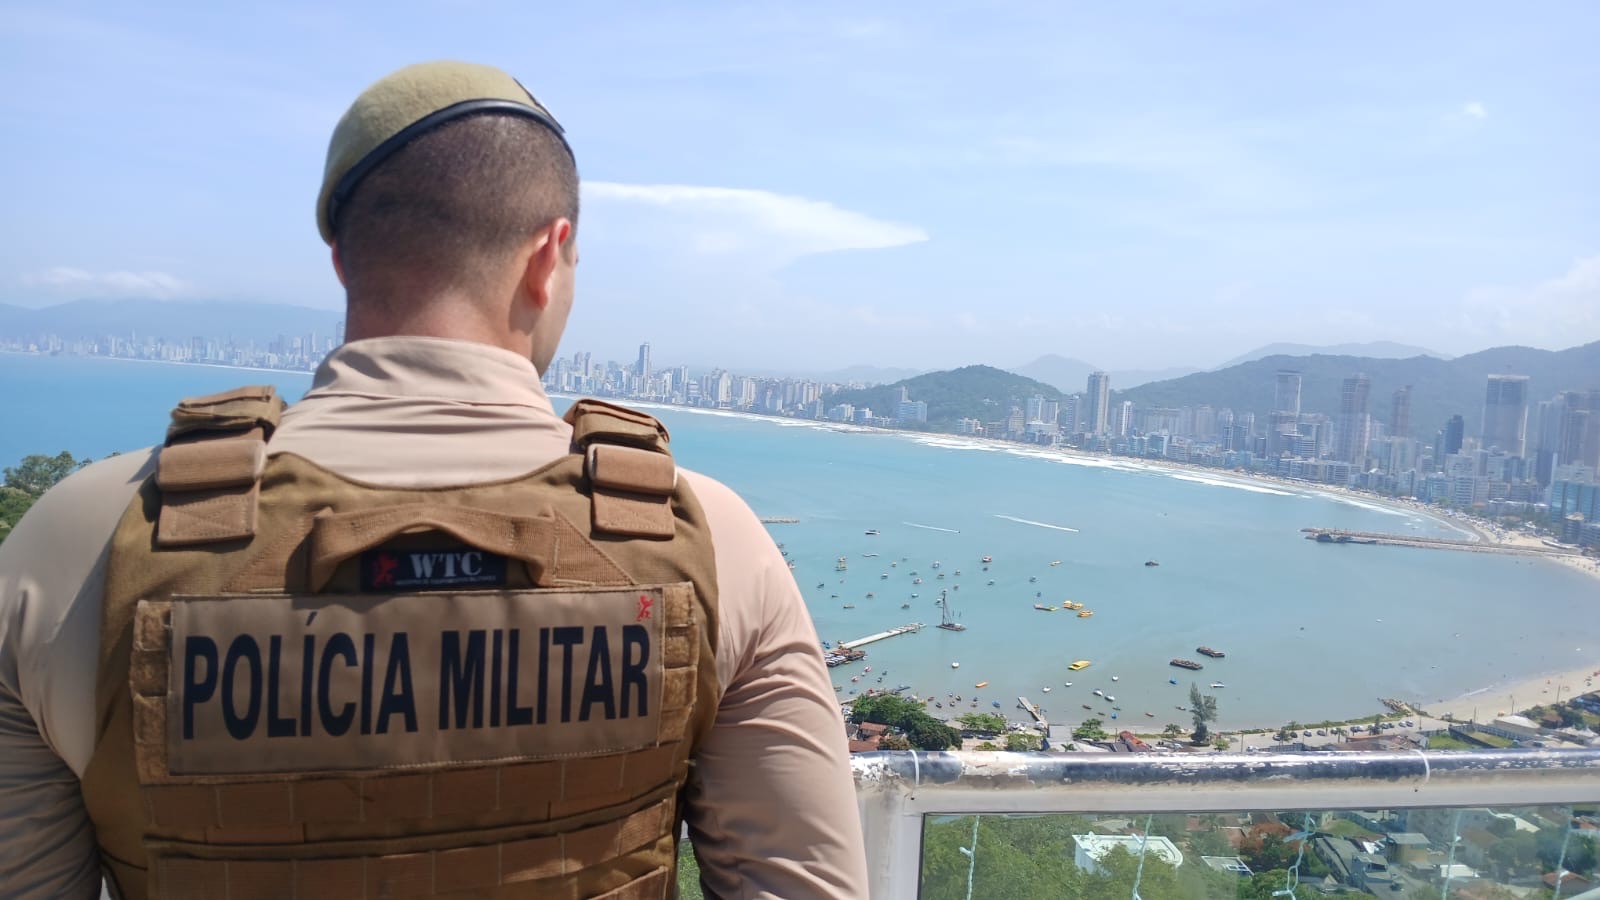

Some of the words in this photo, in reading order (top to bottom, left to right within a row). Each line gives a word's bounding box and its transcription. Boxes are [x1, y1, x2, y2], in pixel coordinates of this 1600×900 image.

[410, 552, 482, 578] WTC
[183, 612, 418, 740] POLÍCIA
[438, 624, 650, 731] MILITAR
